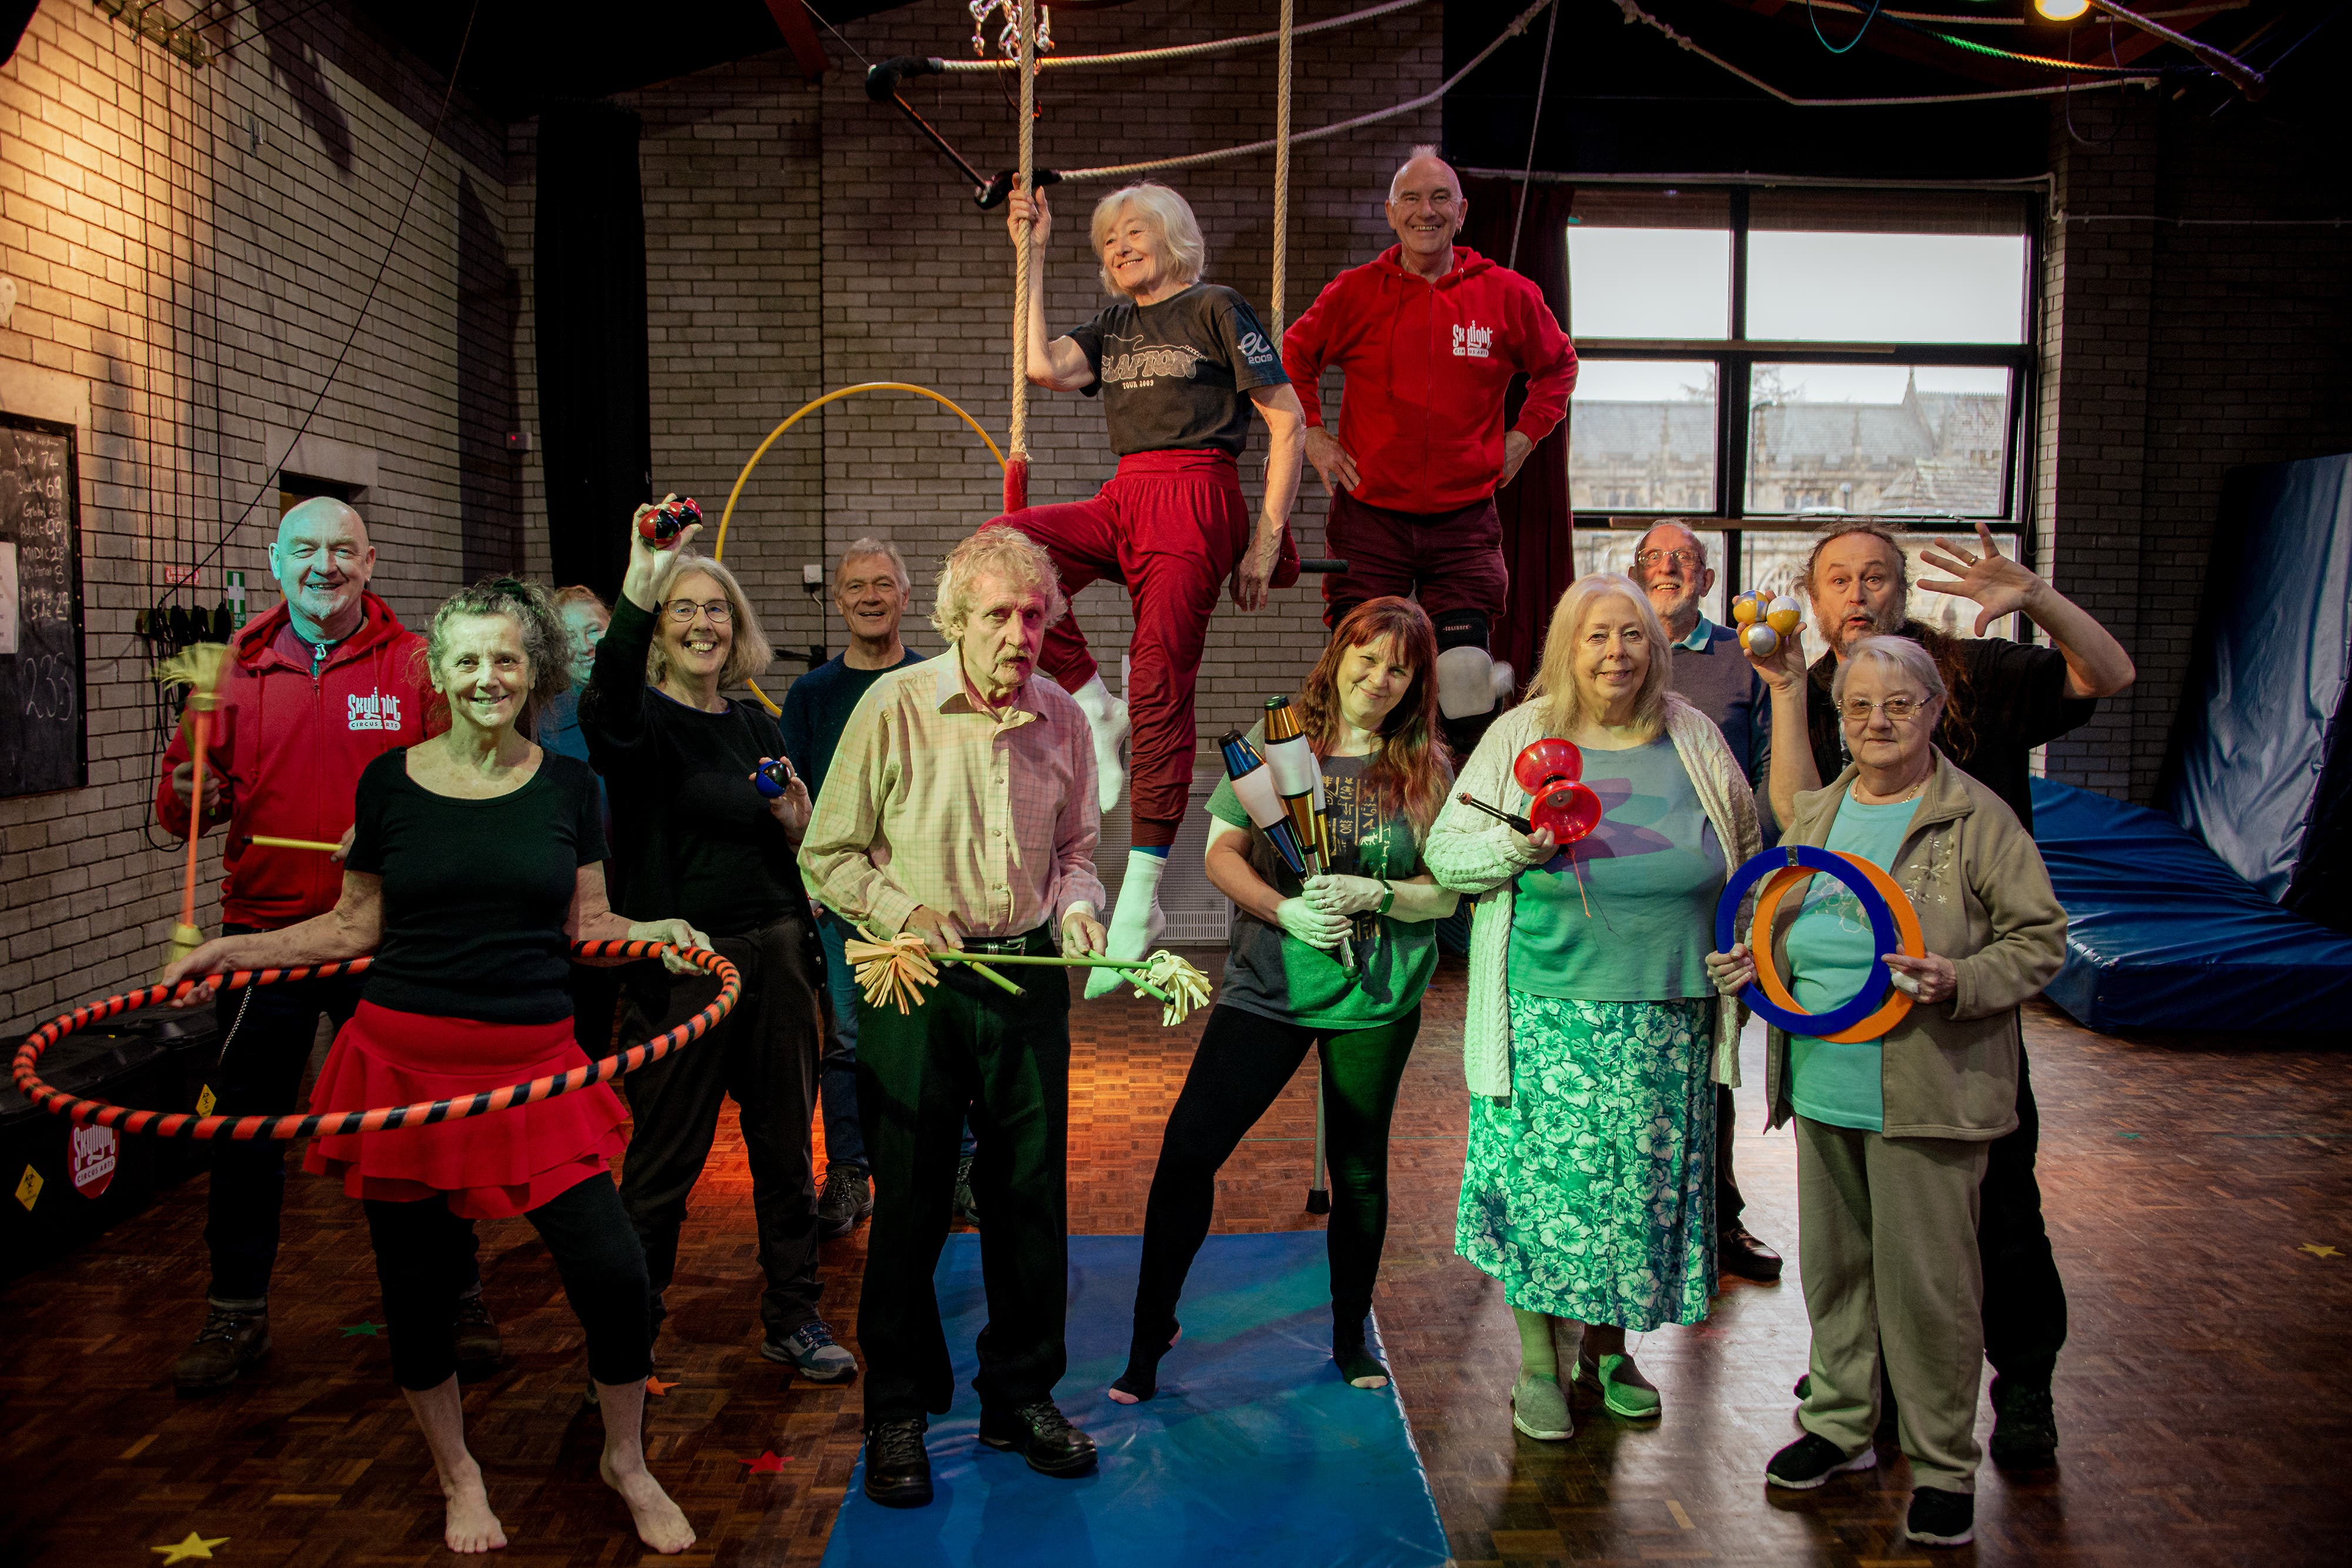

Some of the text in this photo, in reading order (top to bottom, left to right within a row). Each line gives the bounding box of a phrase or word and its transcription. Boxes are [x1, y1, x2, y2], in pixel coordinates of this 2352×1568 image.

[1248, 353, 1272, 364] 2009
[1139, 379, 1154, 387] 2009
[46, 475, 62, 499] 69
[54, 564, 65, 584] 8
[348, 687, 401, 721] Skylight
[77, 1159, 114, 1183] CIRCUS ARTS
